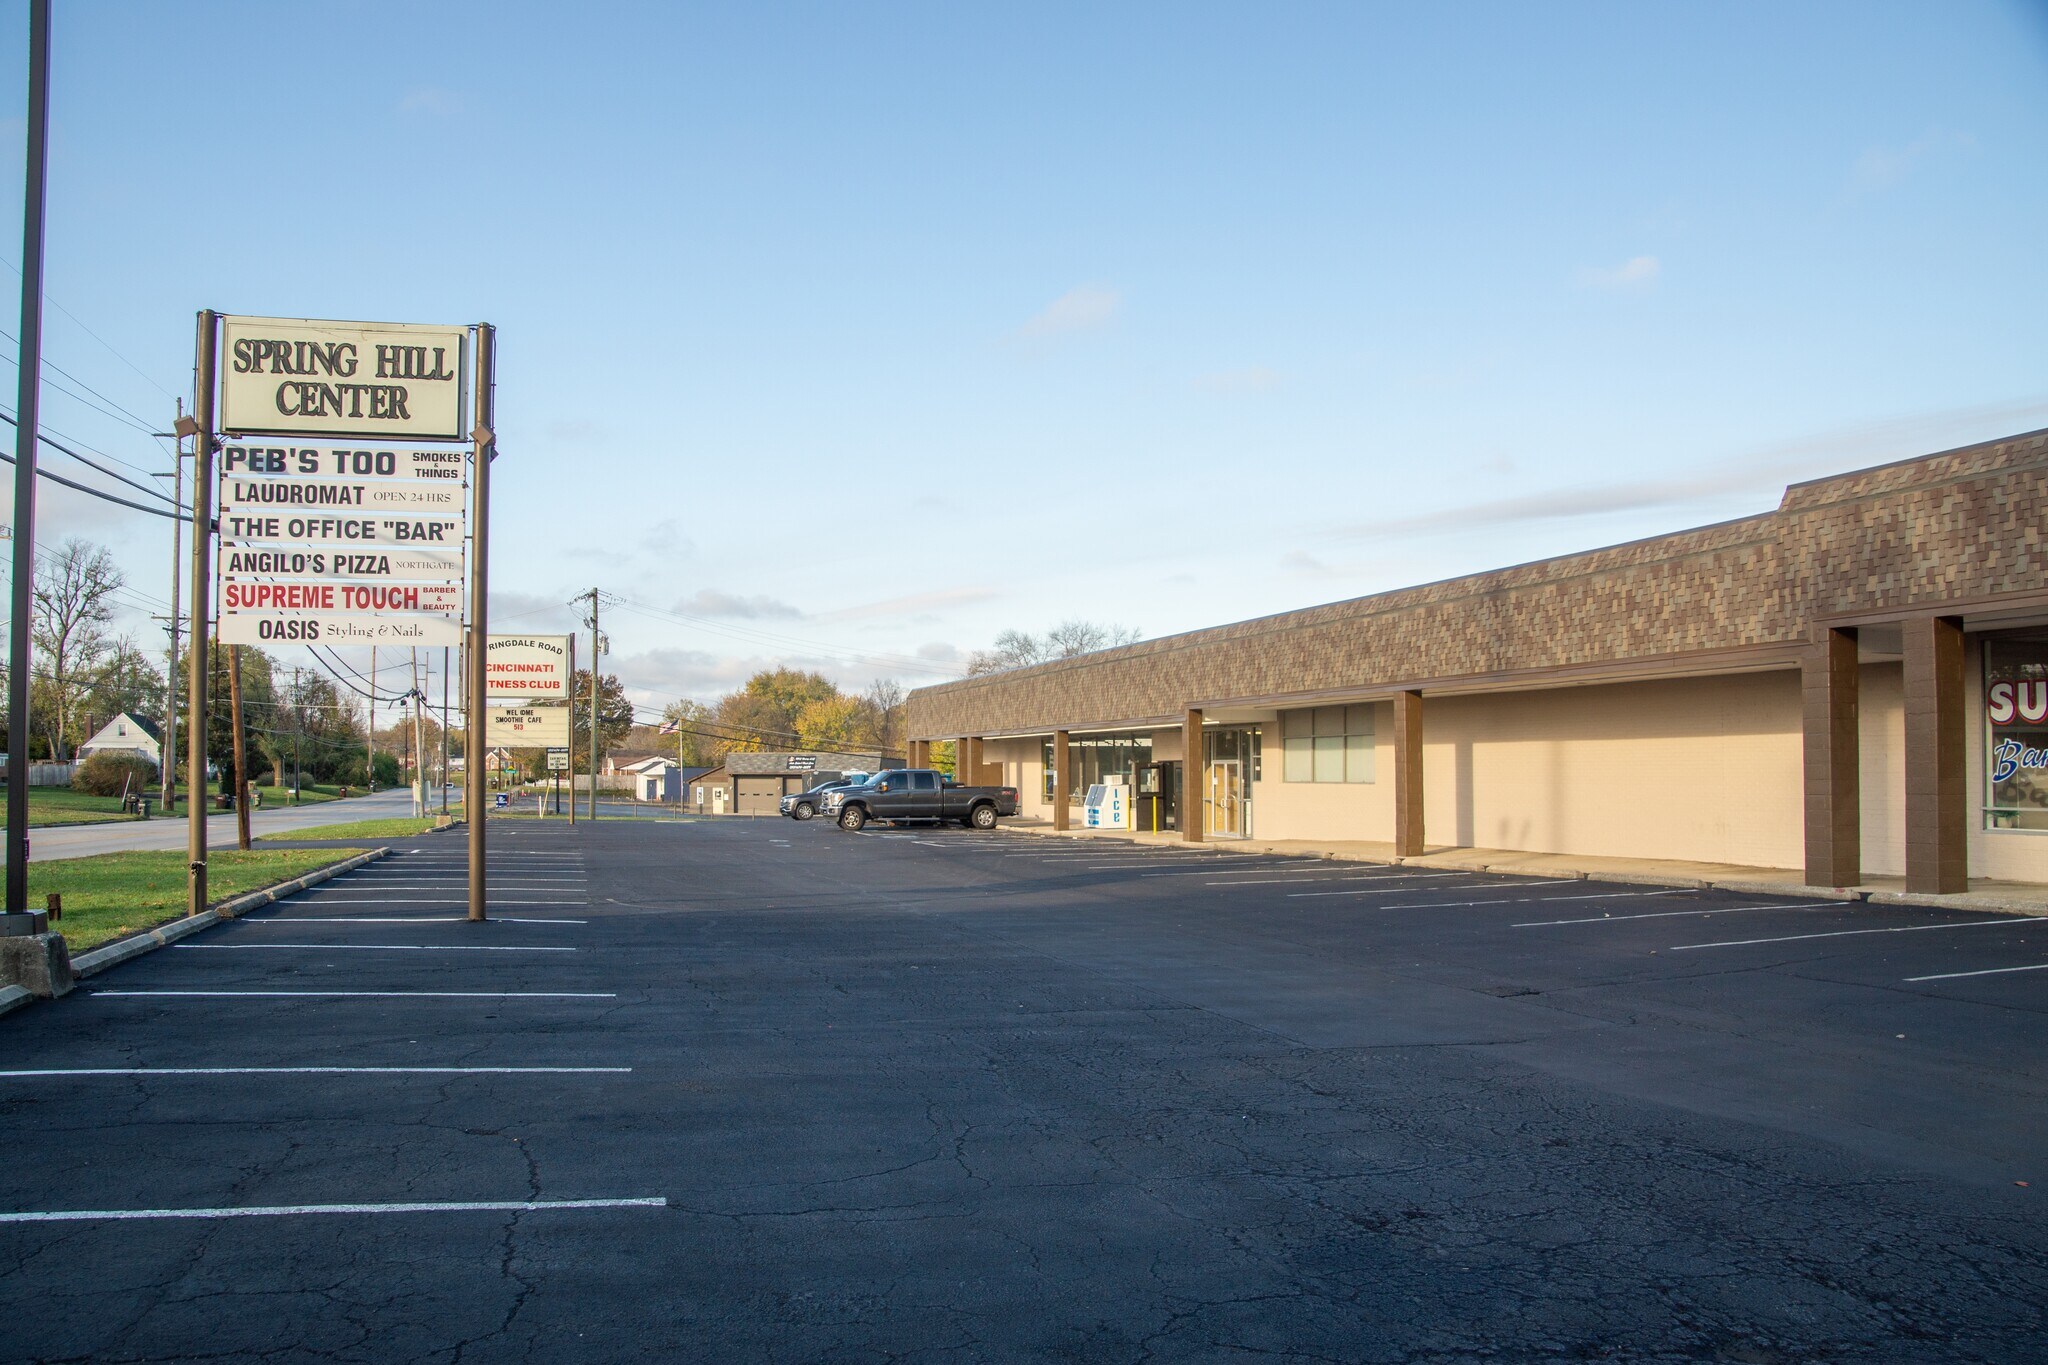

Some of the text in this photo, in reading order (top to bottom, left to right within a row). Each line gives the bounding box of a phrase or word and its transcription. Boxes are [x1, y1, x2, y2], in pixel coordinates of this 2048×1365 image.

[233, 338, 454, 381] SPRING HILL
[275, 380, 411, 420] CENTER
[225, 447, 396, 476] PEB'S TOO
[412, 452, 461, 463] SMOKES
[415, 468, 459, 479] THINGS
[234, 482, 451, 505] LAUDROMAT OPEN 24 HRS
[230, 517, 455, 541] THE OFFICE "BAR"
[229, 552, 455, 575] ANGILO’S PIZZA NORTHGATE
[225, 584, 418, 610] SUPREME TOUCH
[422, 586, 456, 594] BARBER
[422, 603, 456, 611] BEAUTY
[259, 619, 424, 640] OASIS Styling & Nails
[486, 639, 563, 655] RINGDALE ROAD
[485, 664, 554, 673] CINCINNATI
[487, 680, 560, 689] TNESS CLUB
[1988, 679, 2048, 725] SU
